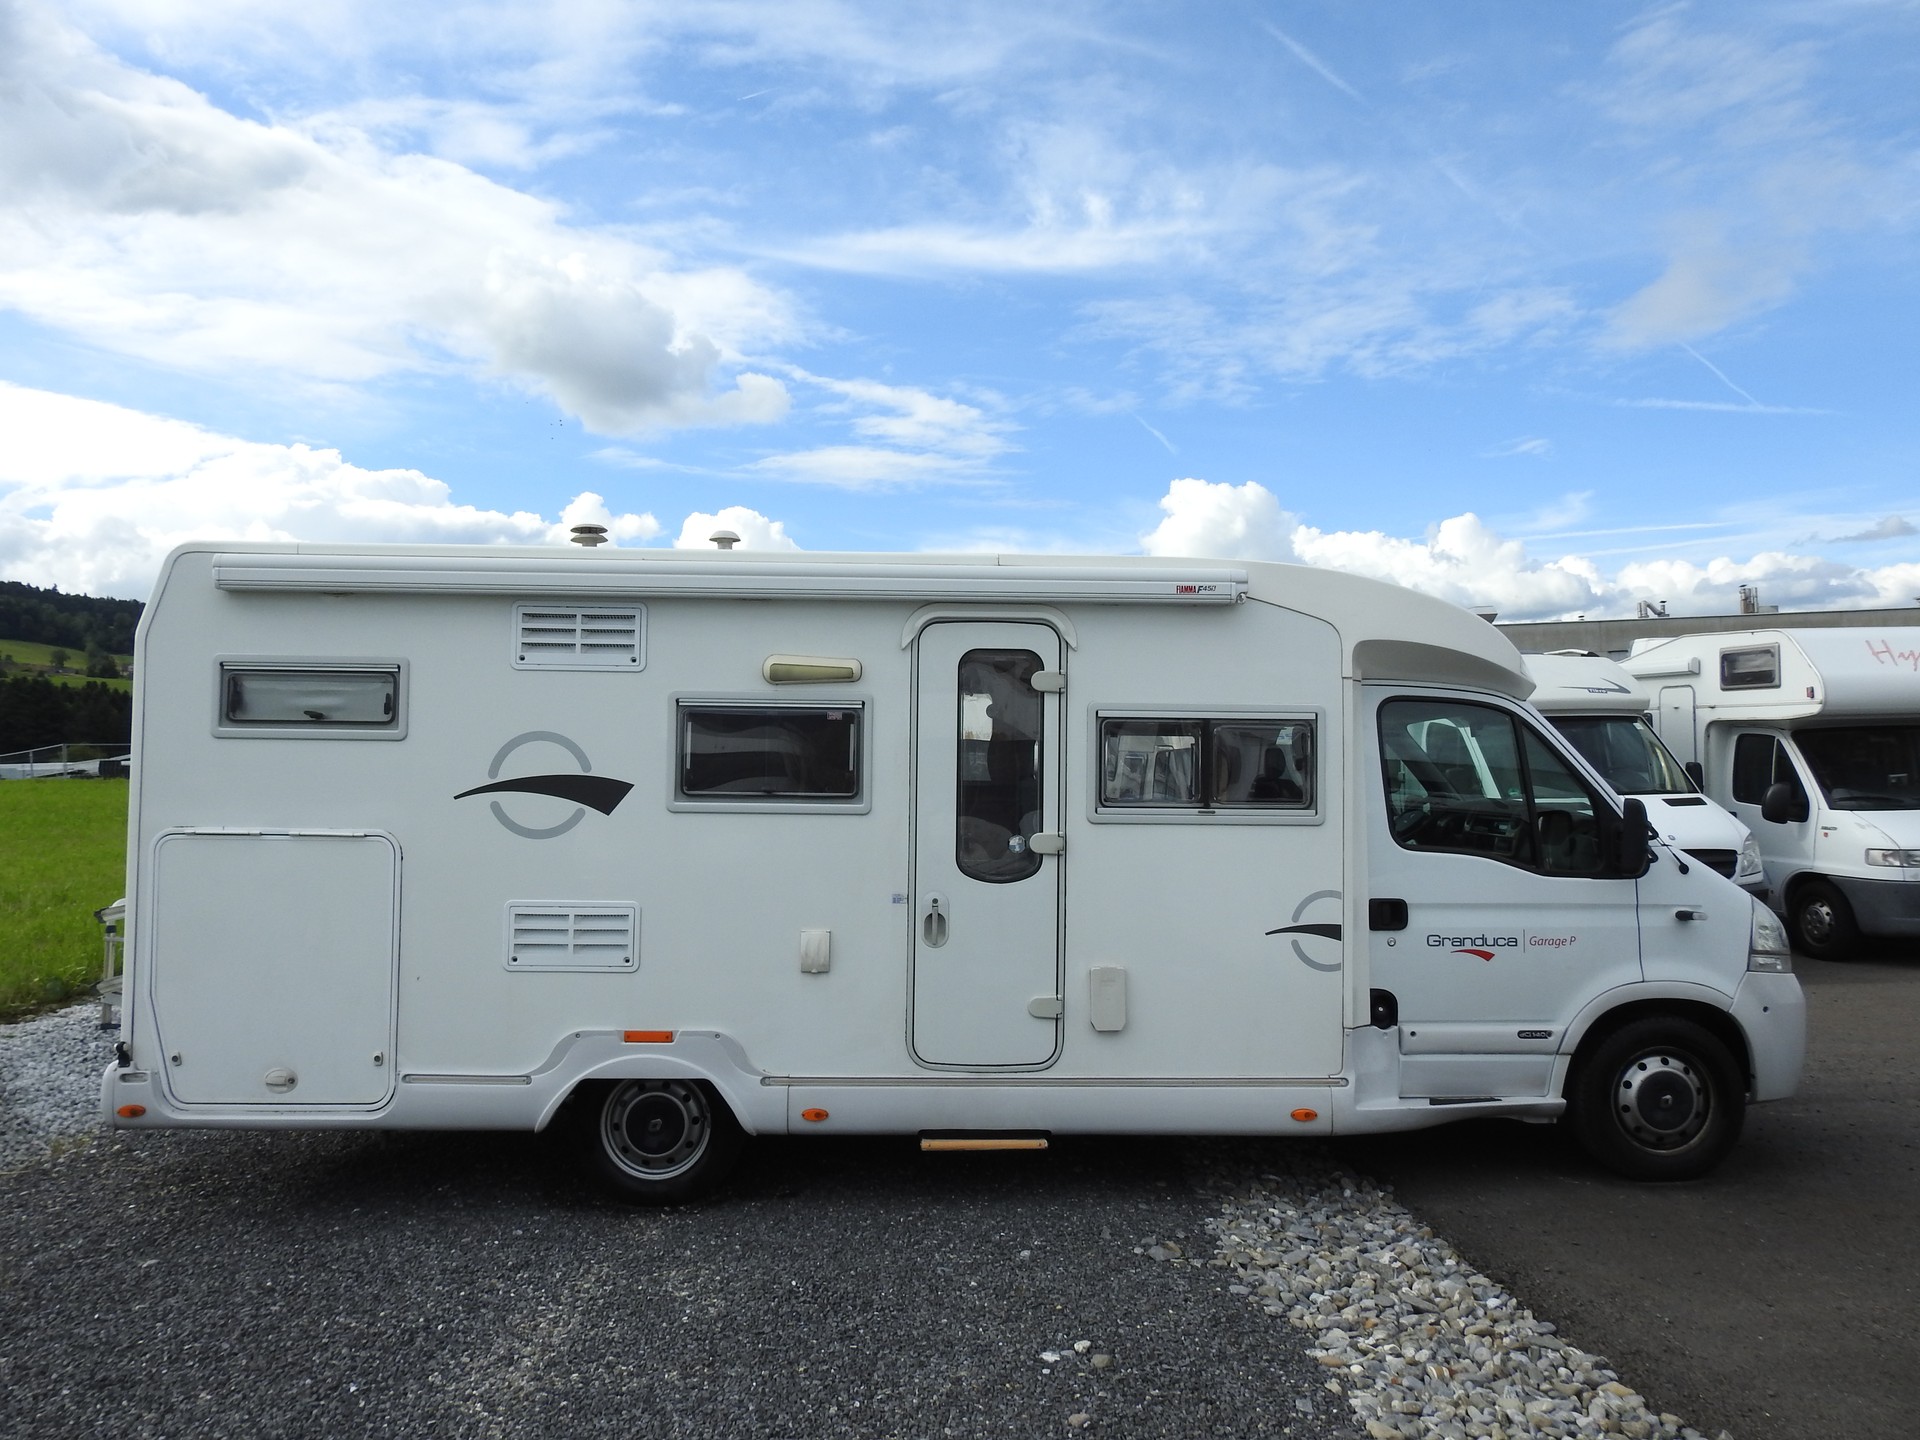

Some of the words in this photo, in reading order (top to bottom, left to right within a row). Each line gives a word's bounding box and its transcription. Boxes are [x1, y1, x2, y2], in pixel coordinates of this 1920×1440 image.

[1176, 585, 1196, 594] FIAMMA
[1426, 933, 1518, 947] Granduca
[1529, 935, 1567, 948] Garage
[1569, 935, 1576, 946] P
